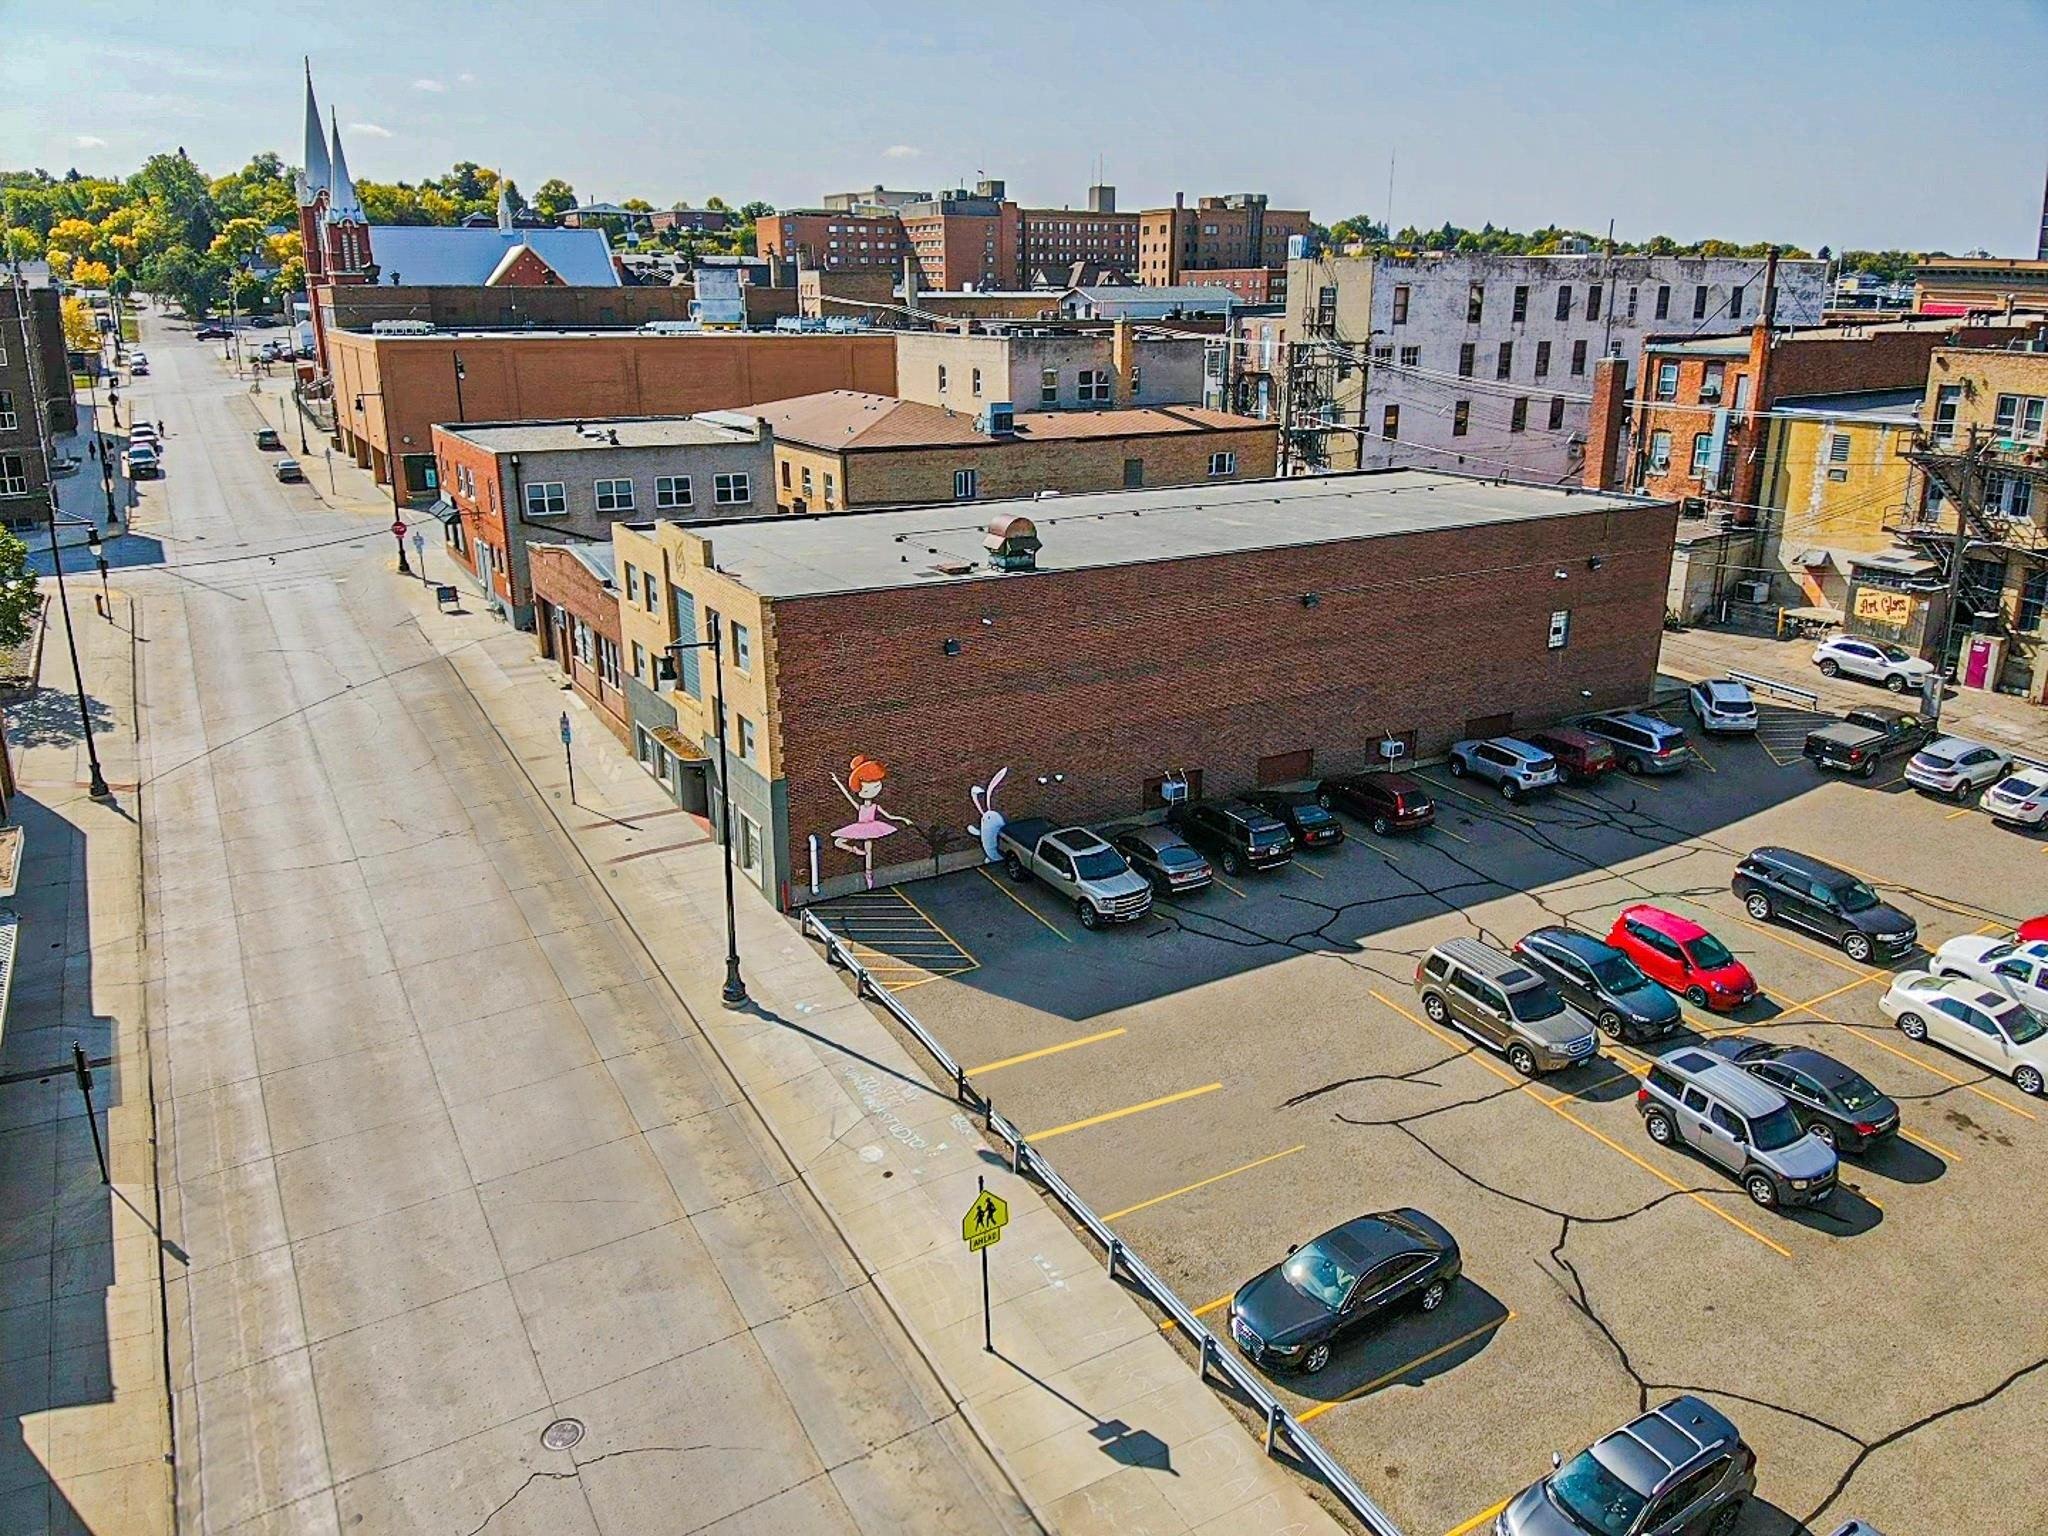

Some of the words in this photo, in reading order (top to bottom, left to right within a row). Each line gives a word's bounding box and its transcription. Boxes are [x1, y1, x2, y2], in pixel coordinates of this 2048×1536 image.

[1860, 598, 1878, 614] Art
[1881, 595, 1907, 616] Glass
[973, 1231, 998, 1247] AHEAD
